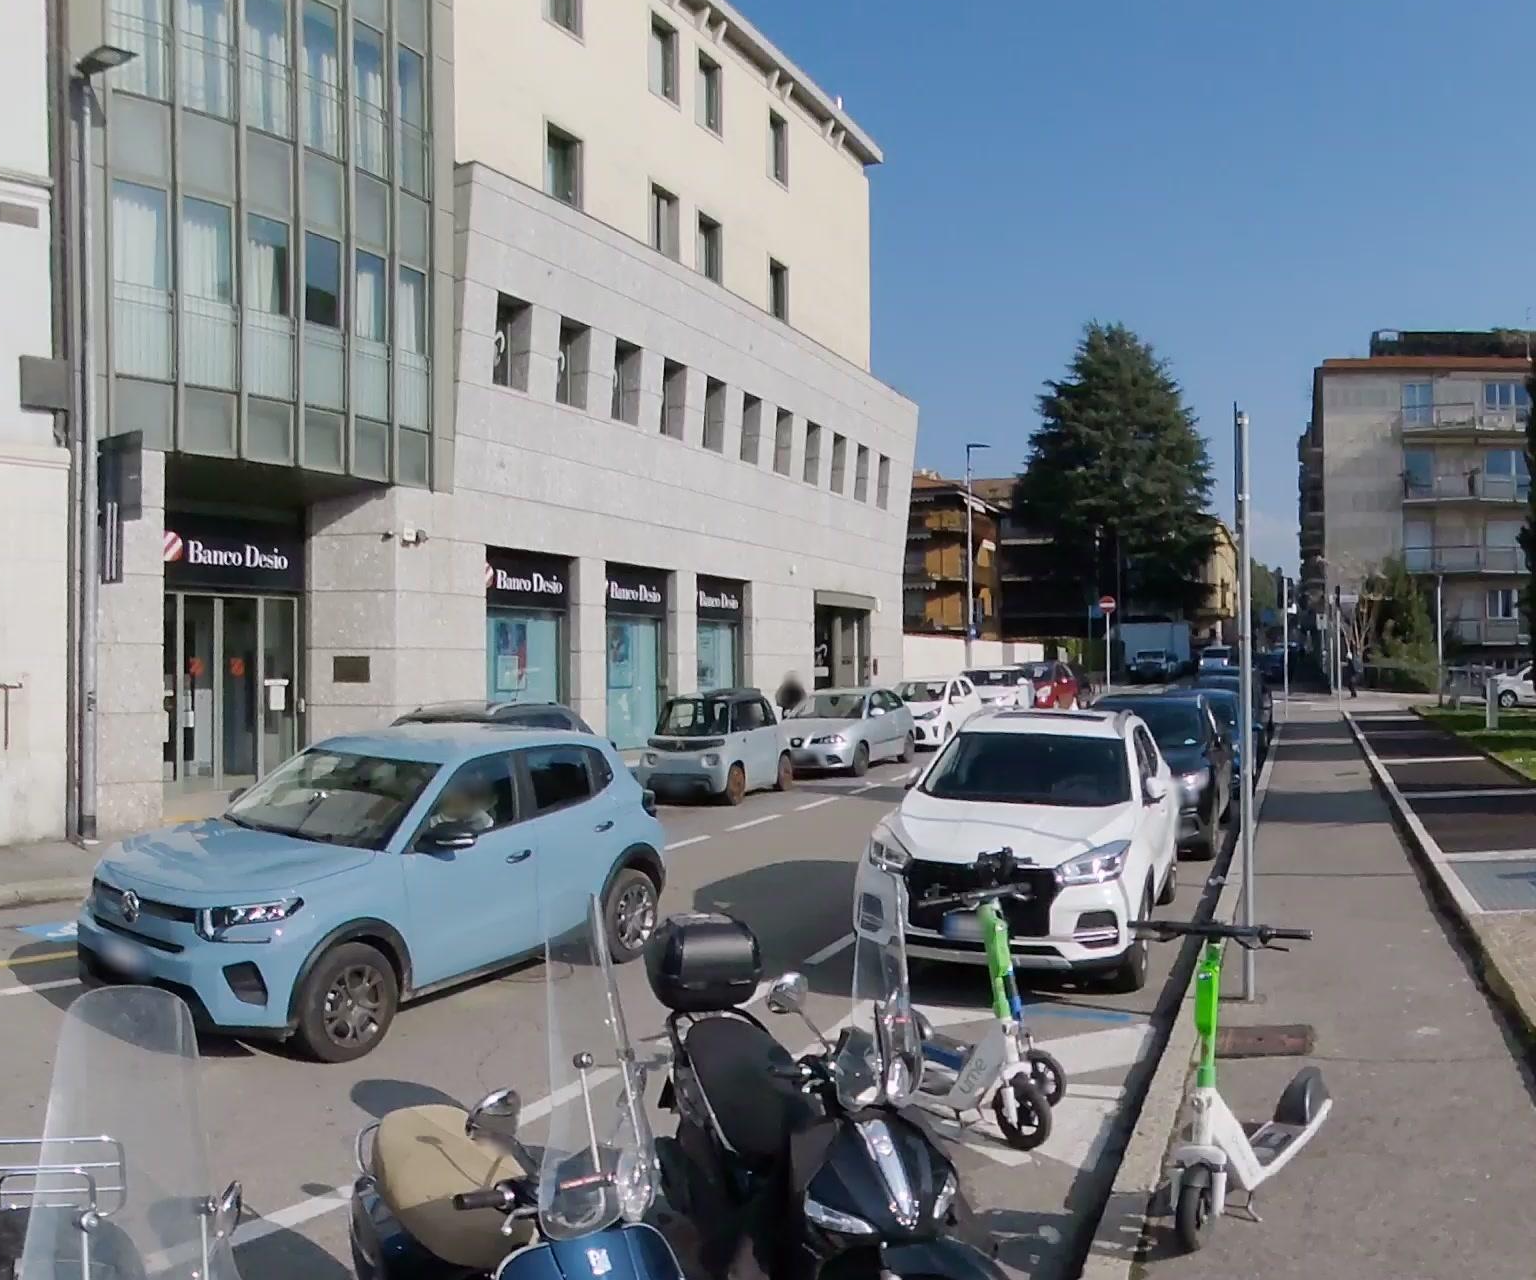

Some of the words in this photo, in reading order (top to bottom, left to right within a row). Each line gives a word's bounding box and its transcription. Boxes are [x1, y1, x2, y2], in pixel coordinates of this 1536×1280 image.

[187, 539, 242, 567] Banco
[245, 543, 289, 570] Desio
[495, 568, 532, 593] Banco
[532, 572, 564, 596] Desio
[609, 581, 639, 602] Banco
[639, 582, 662, 604] Desio
[699, 590, 720, 608] Banco
[720, 592, 739, 610] Desio
